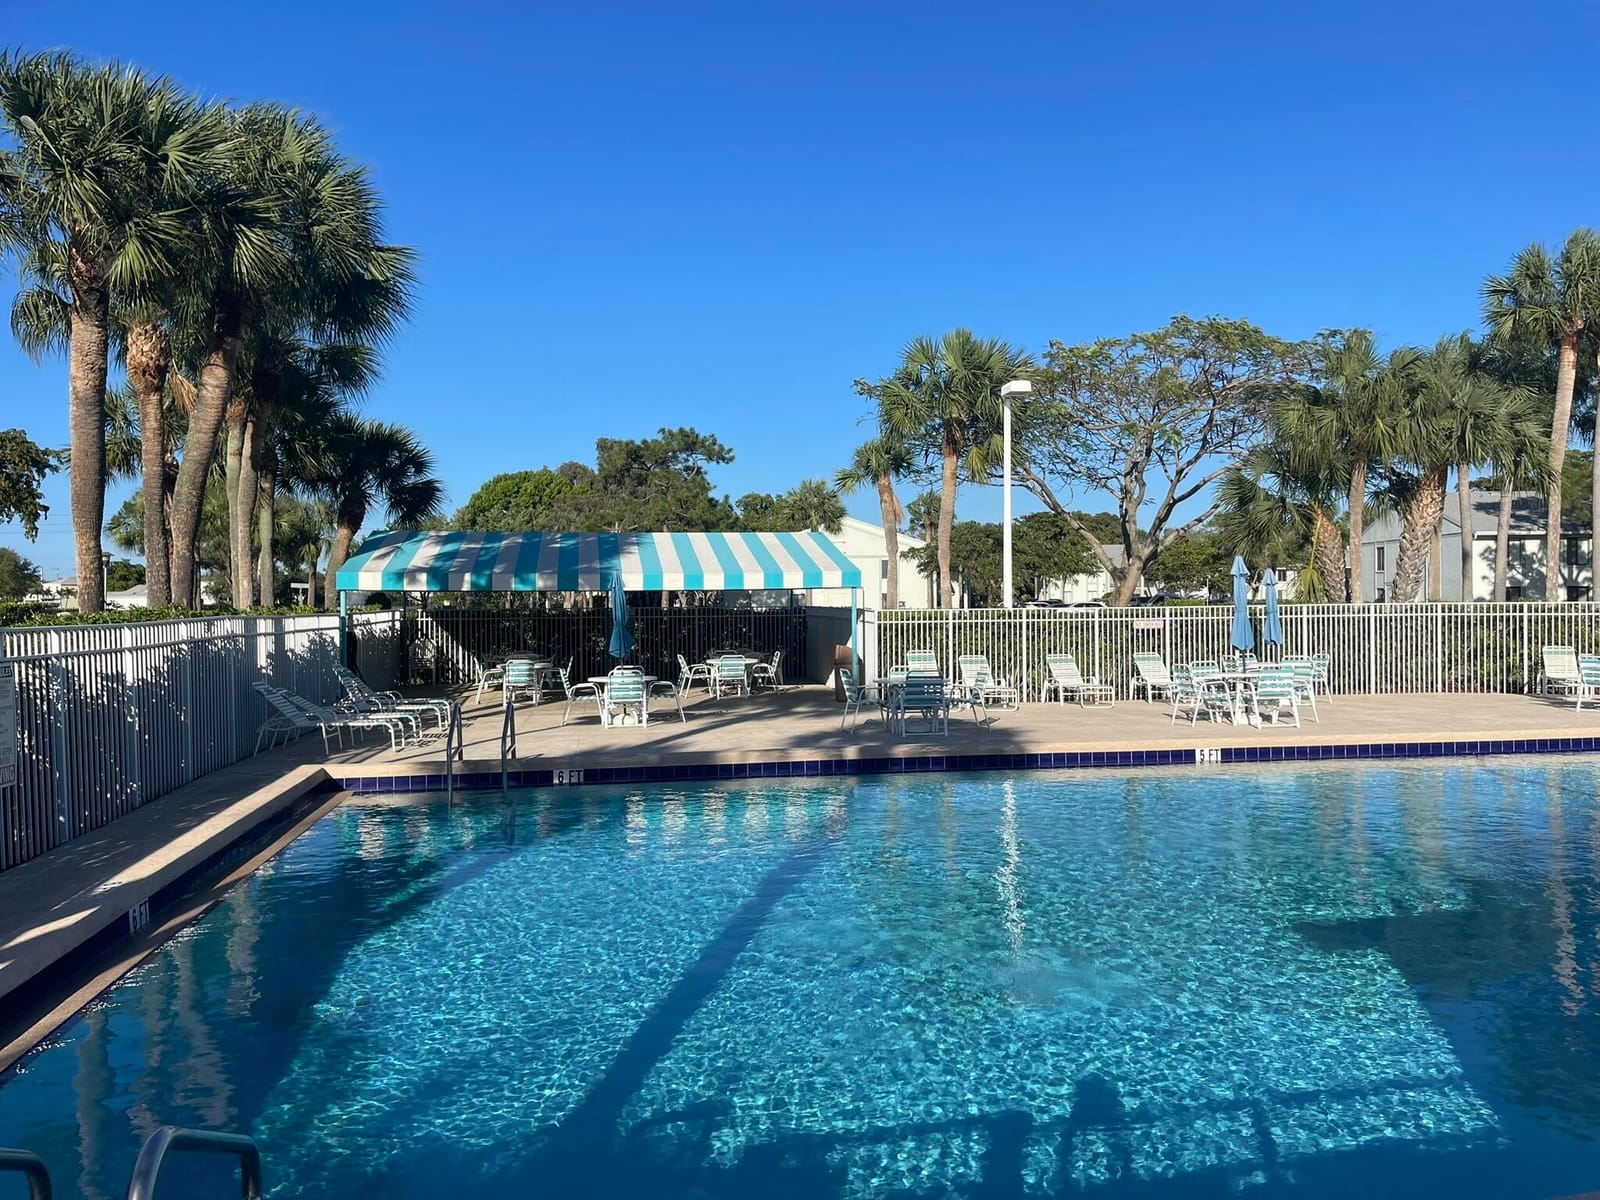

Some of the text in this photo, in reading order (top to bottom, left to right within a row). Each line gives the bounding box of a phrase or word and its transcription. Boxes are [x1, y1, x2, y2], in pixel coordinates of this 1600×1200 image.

[1199, 748, 1219, 763] 5 FT
[558, 769, 582, 785] 6 FT
[132, 900, 148, 930] 6 FT
